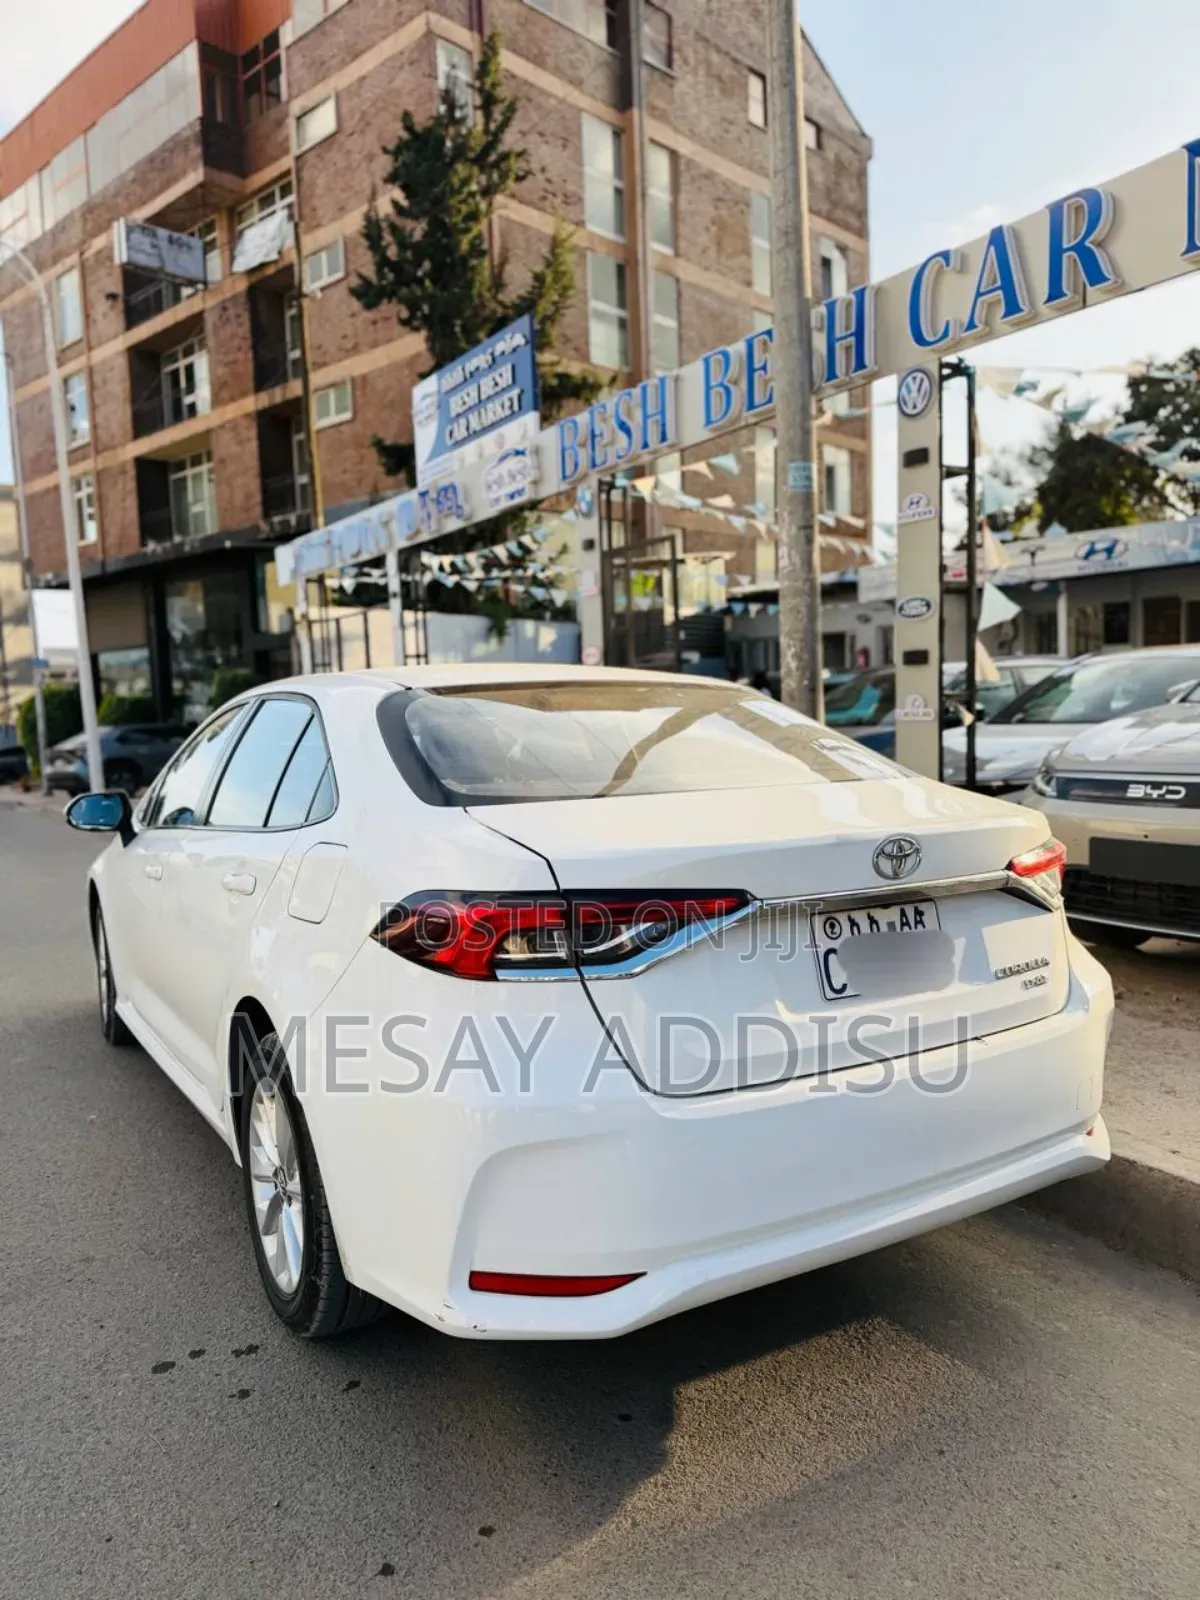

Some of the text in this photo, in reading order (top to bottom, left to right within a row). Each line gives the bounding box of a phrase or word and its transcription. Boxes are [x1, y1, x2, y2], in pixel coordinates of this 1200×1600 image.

[558, 372, 669, 482] BESH
[701, 284, 872, 429] BEH
[907, 186, 1113, 348] CAR
[445, 417, 469, 446] CAR
[469, 386, 522, 435] MARKET
[448, 382, 479, 417] BESH
[480, 362, 513, 400] BESH
[1126, 783, 1186, 800] BYD
